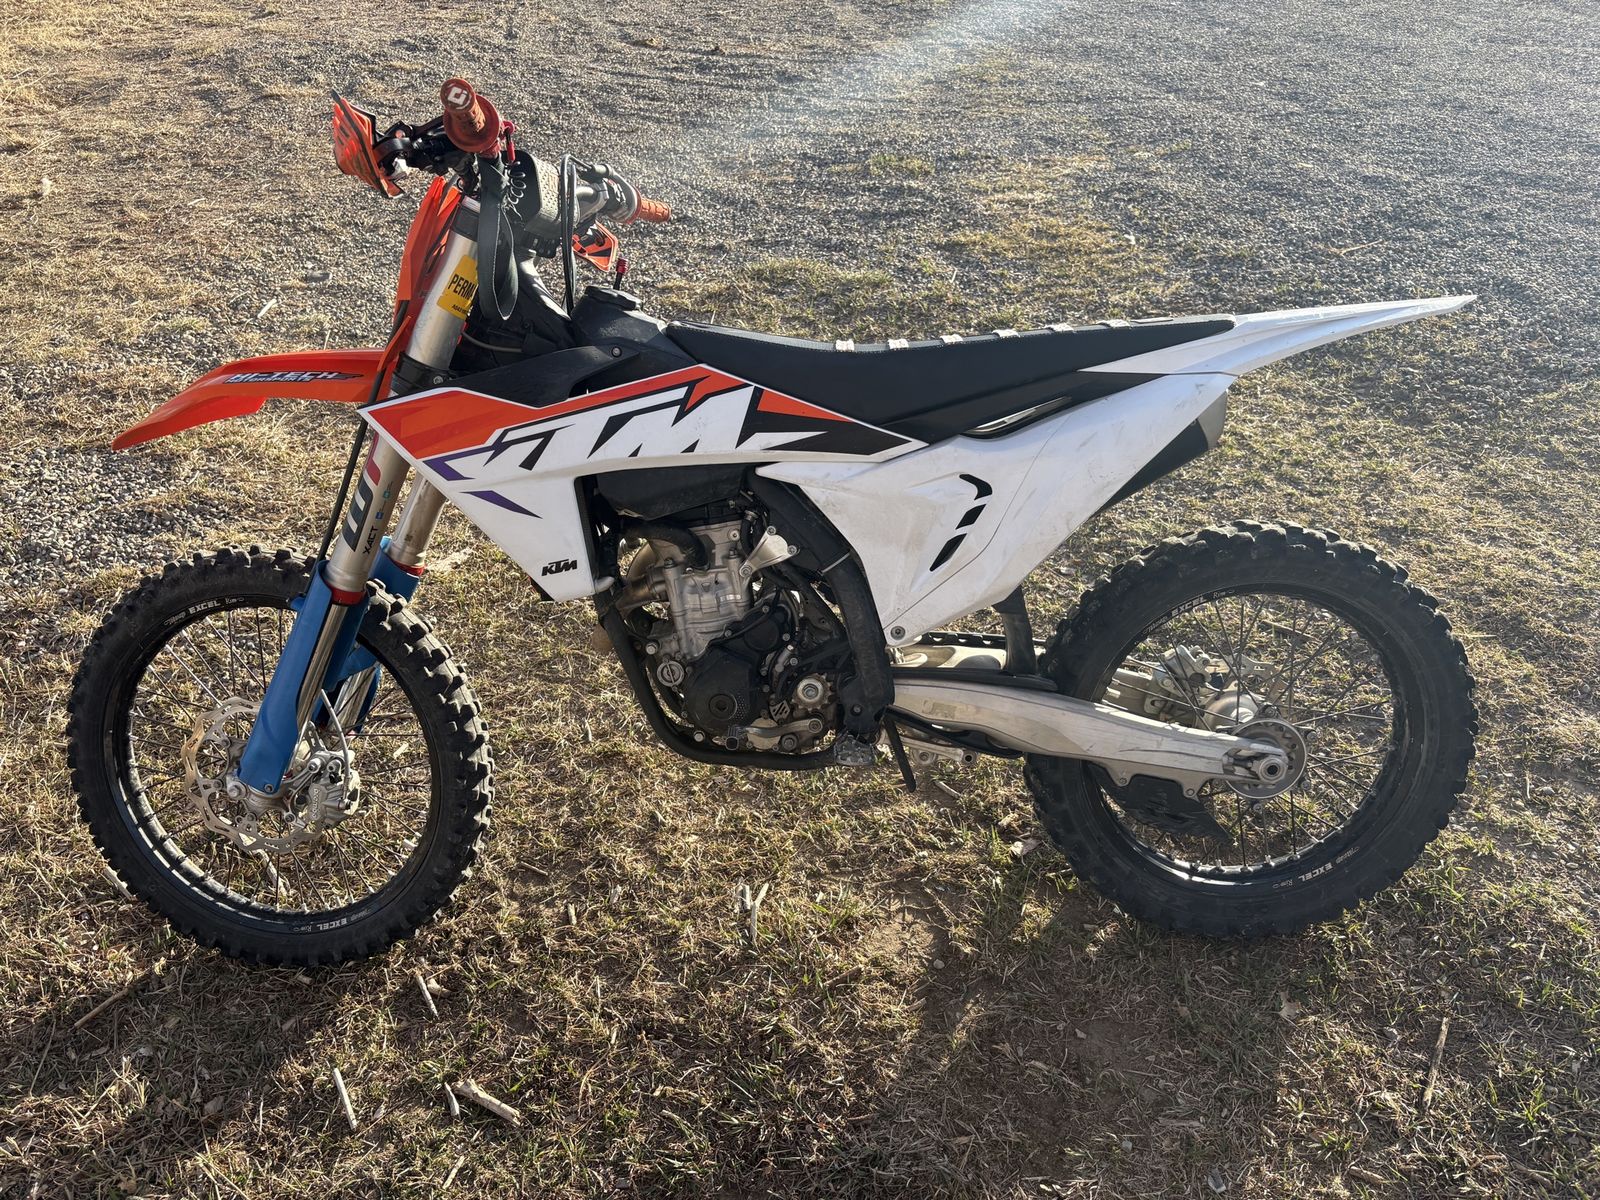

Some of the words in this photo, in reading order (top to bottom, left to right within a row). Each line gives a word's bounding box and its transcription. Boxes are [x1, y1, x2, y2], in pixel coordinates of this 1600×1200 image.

[230, 371, 340, 382] HI-TECH
[443, 385, 757, 478] KTM
[363, 525, 379, 555] XACT
[541, 558, 578, 577] KTM
[188, 600, 221, 615] EXCEL
[1171, 596, 1209, 617] EXCEL
[1298, 862, 1334, 882] EXCEL
[316, 917, 348, 931] EXCEL
